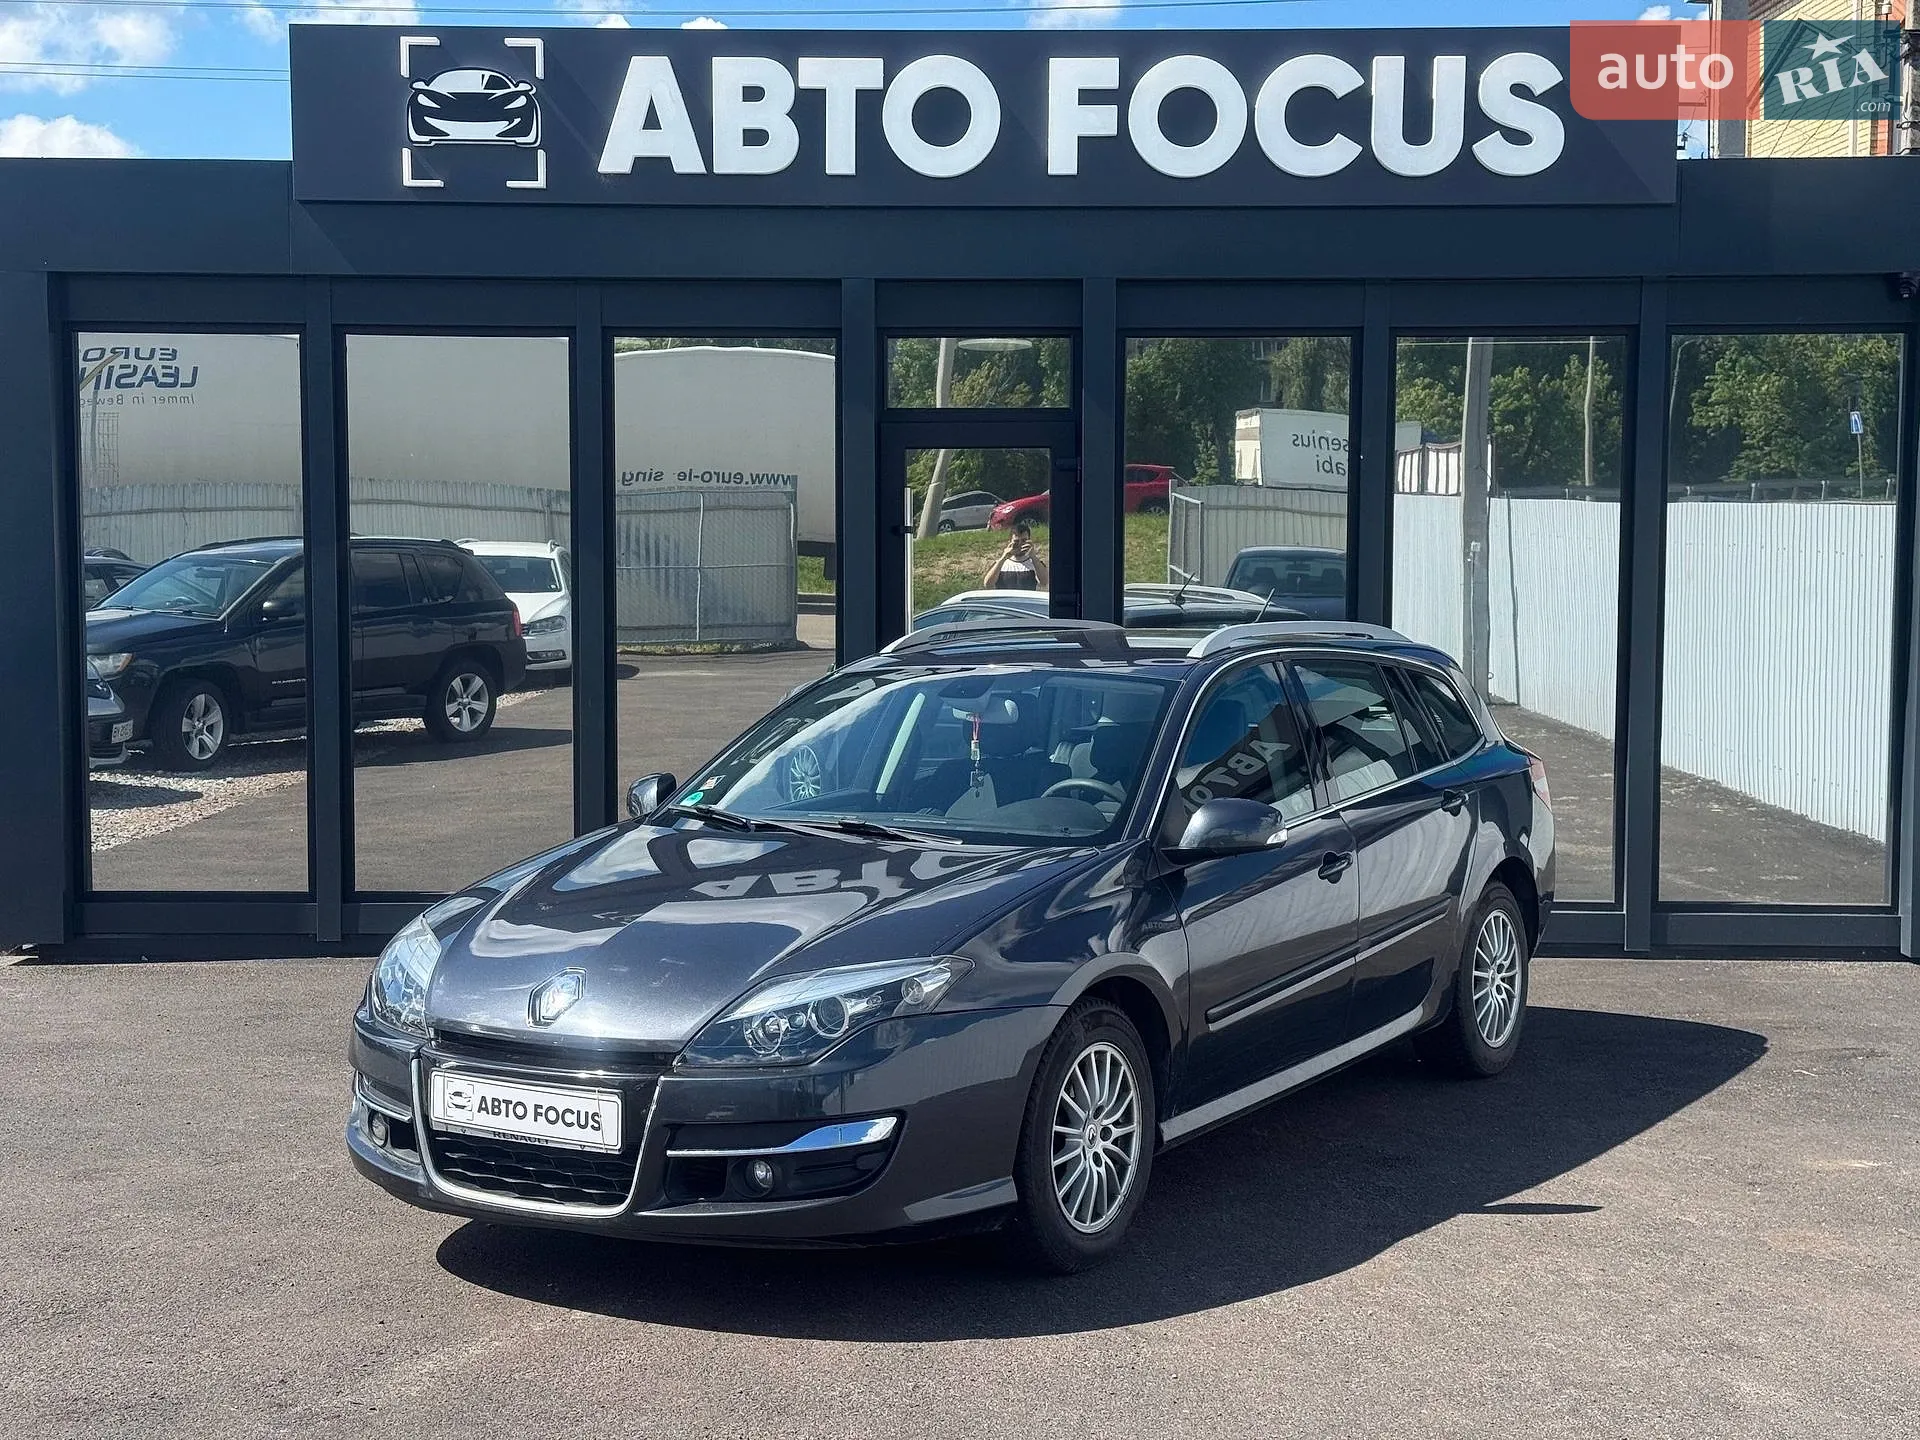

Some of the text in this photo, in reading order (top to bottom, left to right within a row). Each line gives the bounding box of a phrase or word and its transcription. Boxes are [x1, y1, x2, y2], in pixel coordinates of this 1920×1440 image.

[598, 52, 1566, 178] АВТО FOCUS
[533, 1103, 602, 1132] FOCUS
